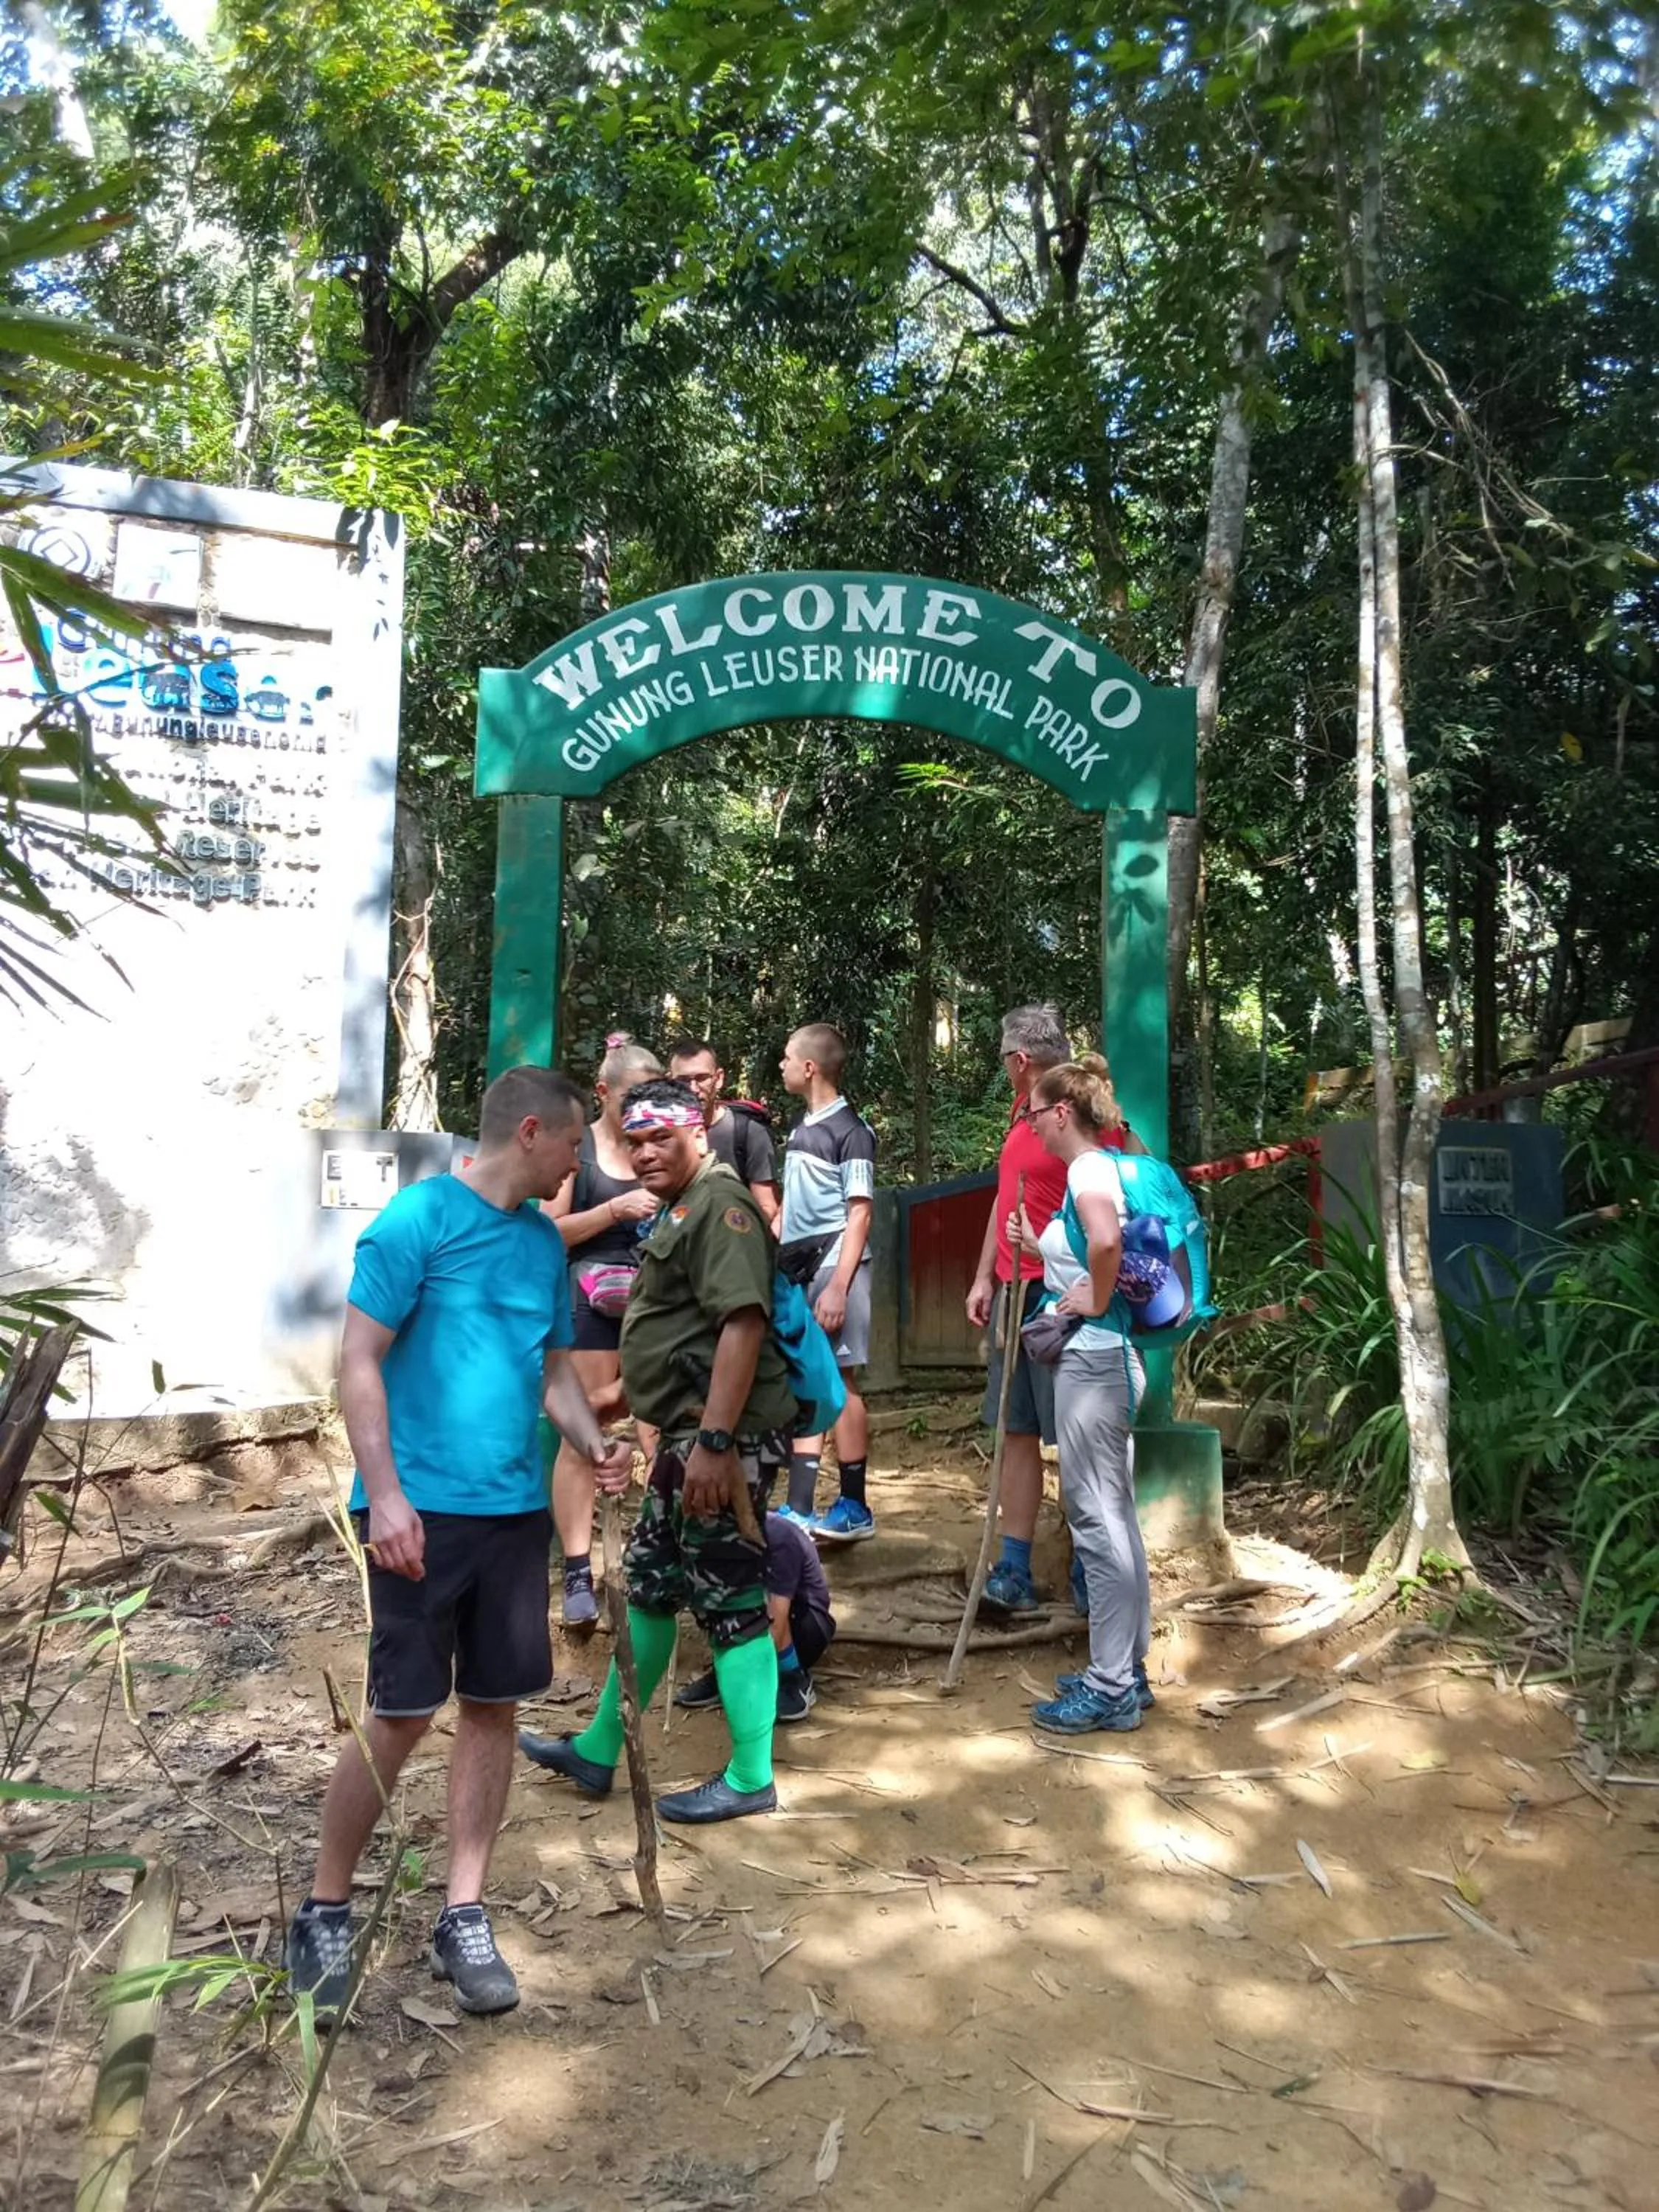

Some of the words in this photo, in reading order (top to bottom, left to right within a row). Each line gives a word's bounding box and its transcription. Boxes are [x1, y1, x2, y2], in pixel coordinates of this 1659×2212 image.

[532, 585, 981, 710] WELCOME
[1015, 622, 1141, 728] TO
[562, 670, 694, 771] GUNUNG
[701, 644, 843, 697] LEUSER
[855, 647, 1013, 720] NATIONAL
[1024, 695, 1109, 782] PARK
